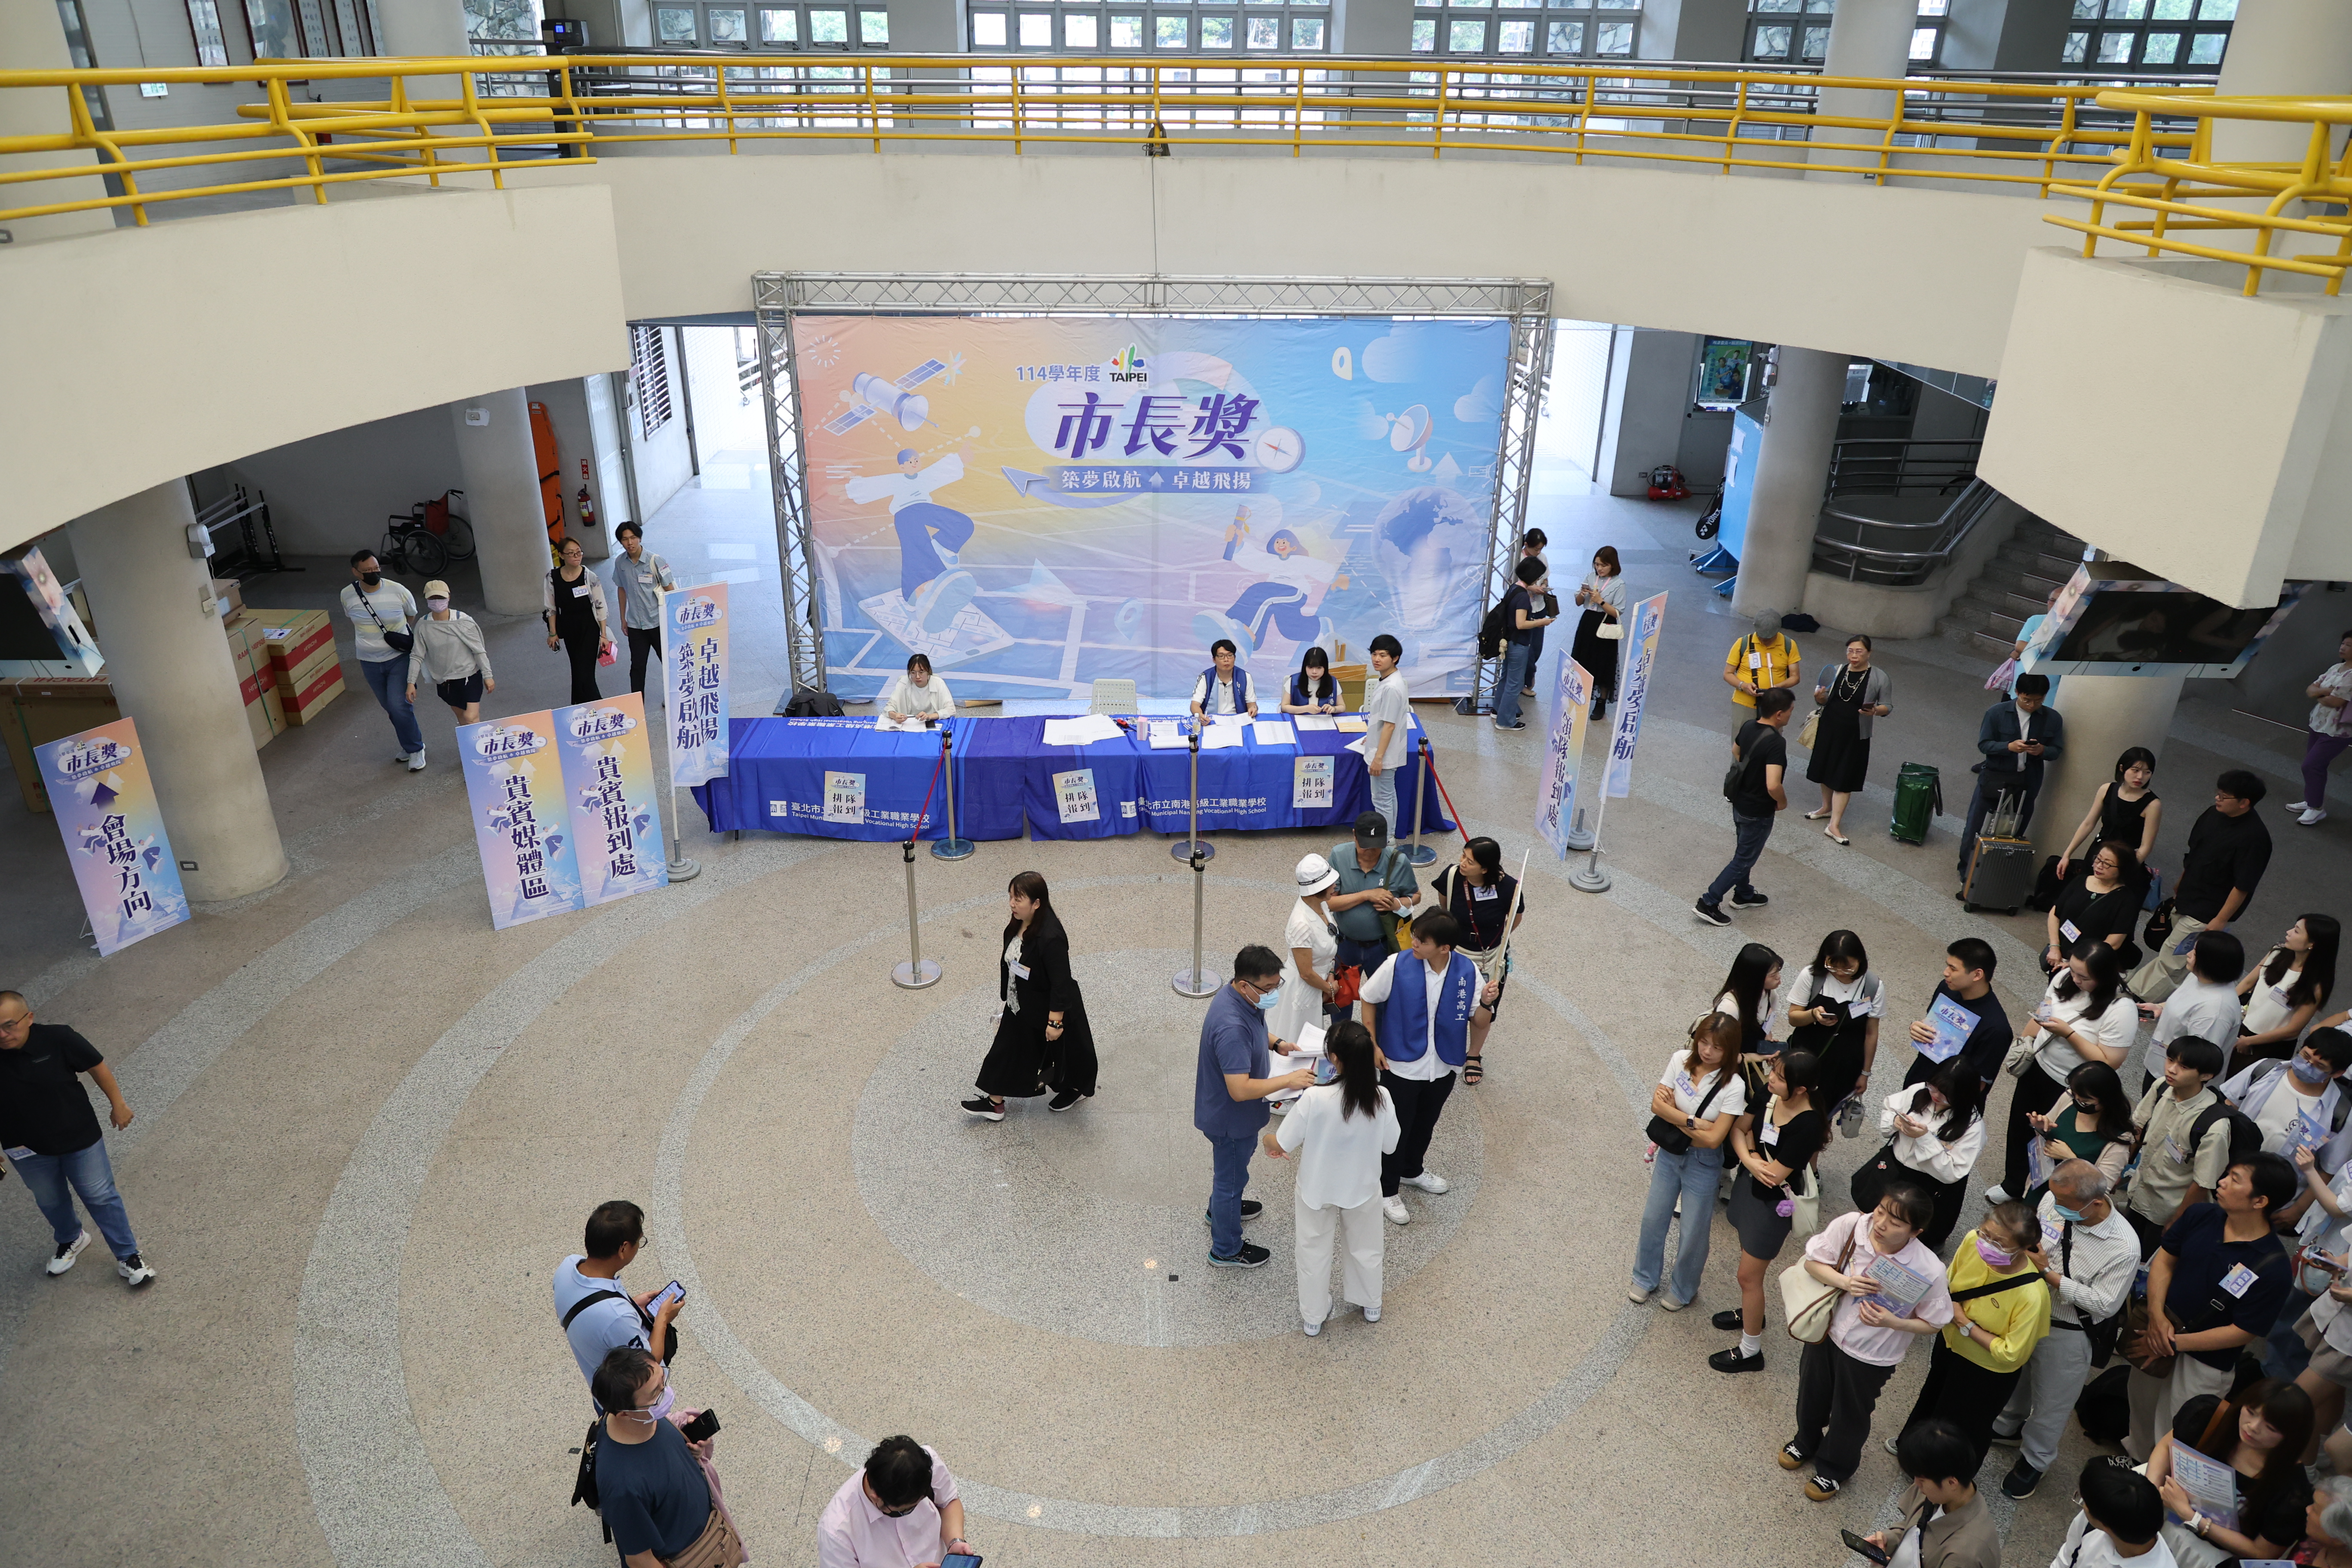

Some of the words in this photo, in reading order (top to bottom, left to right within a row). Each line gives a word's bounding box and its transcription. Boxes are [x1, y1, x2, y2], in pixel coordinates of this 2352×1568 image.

[1016, 364, 1100, 382] 114學年度
[1109, 373, 1147, 383] TAIPEI
[1054, 392, 1260, 459] 市長獎
[1061, 470, 1142, 489] 築夢啟航
[1172, 470, 1251, 490] 卓越飛揚
[1706, 508, 1722, 526] YONEX
[680, 603, 715, 624] 市長獎
[676, 642, 701, 750] 築夢啟航
[698, 637, 720, 744] 卓越飛揚
[578, 714, 625, 736] 市長獎
[484, 732, 534, 754] 市長獎
[66, 743, 117, 772] 市長獎
[1547, 711, 1572, 828] 領隊報到處
[1302, 777, 1325, 787] 排隊
[833, 793, 856, 804] 排隊
[1065, 791, 1088, 802] 排隊
[1302, 789, 1325, 799] 報到
[594, 757, 636, 879] 貴賓報到處
[833, 804, 856, 815] 報到
[1068, 802, 1090, 814] 報到
[1139, 807, 1151, 815] Taipei
[865, 818, 895, 827] Vocational
[502, 775, 549, 900] 貴賓媒體區
[101, 815, 152, 919] 會場方向
[1455, 977, 1467, 1021] 南港高工
[1941, 1007, 1967, 1026] 市長獎
